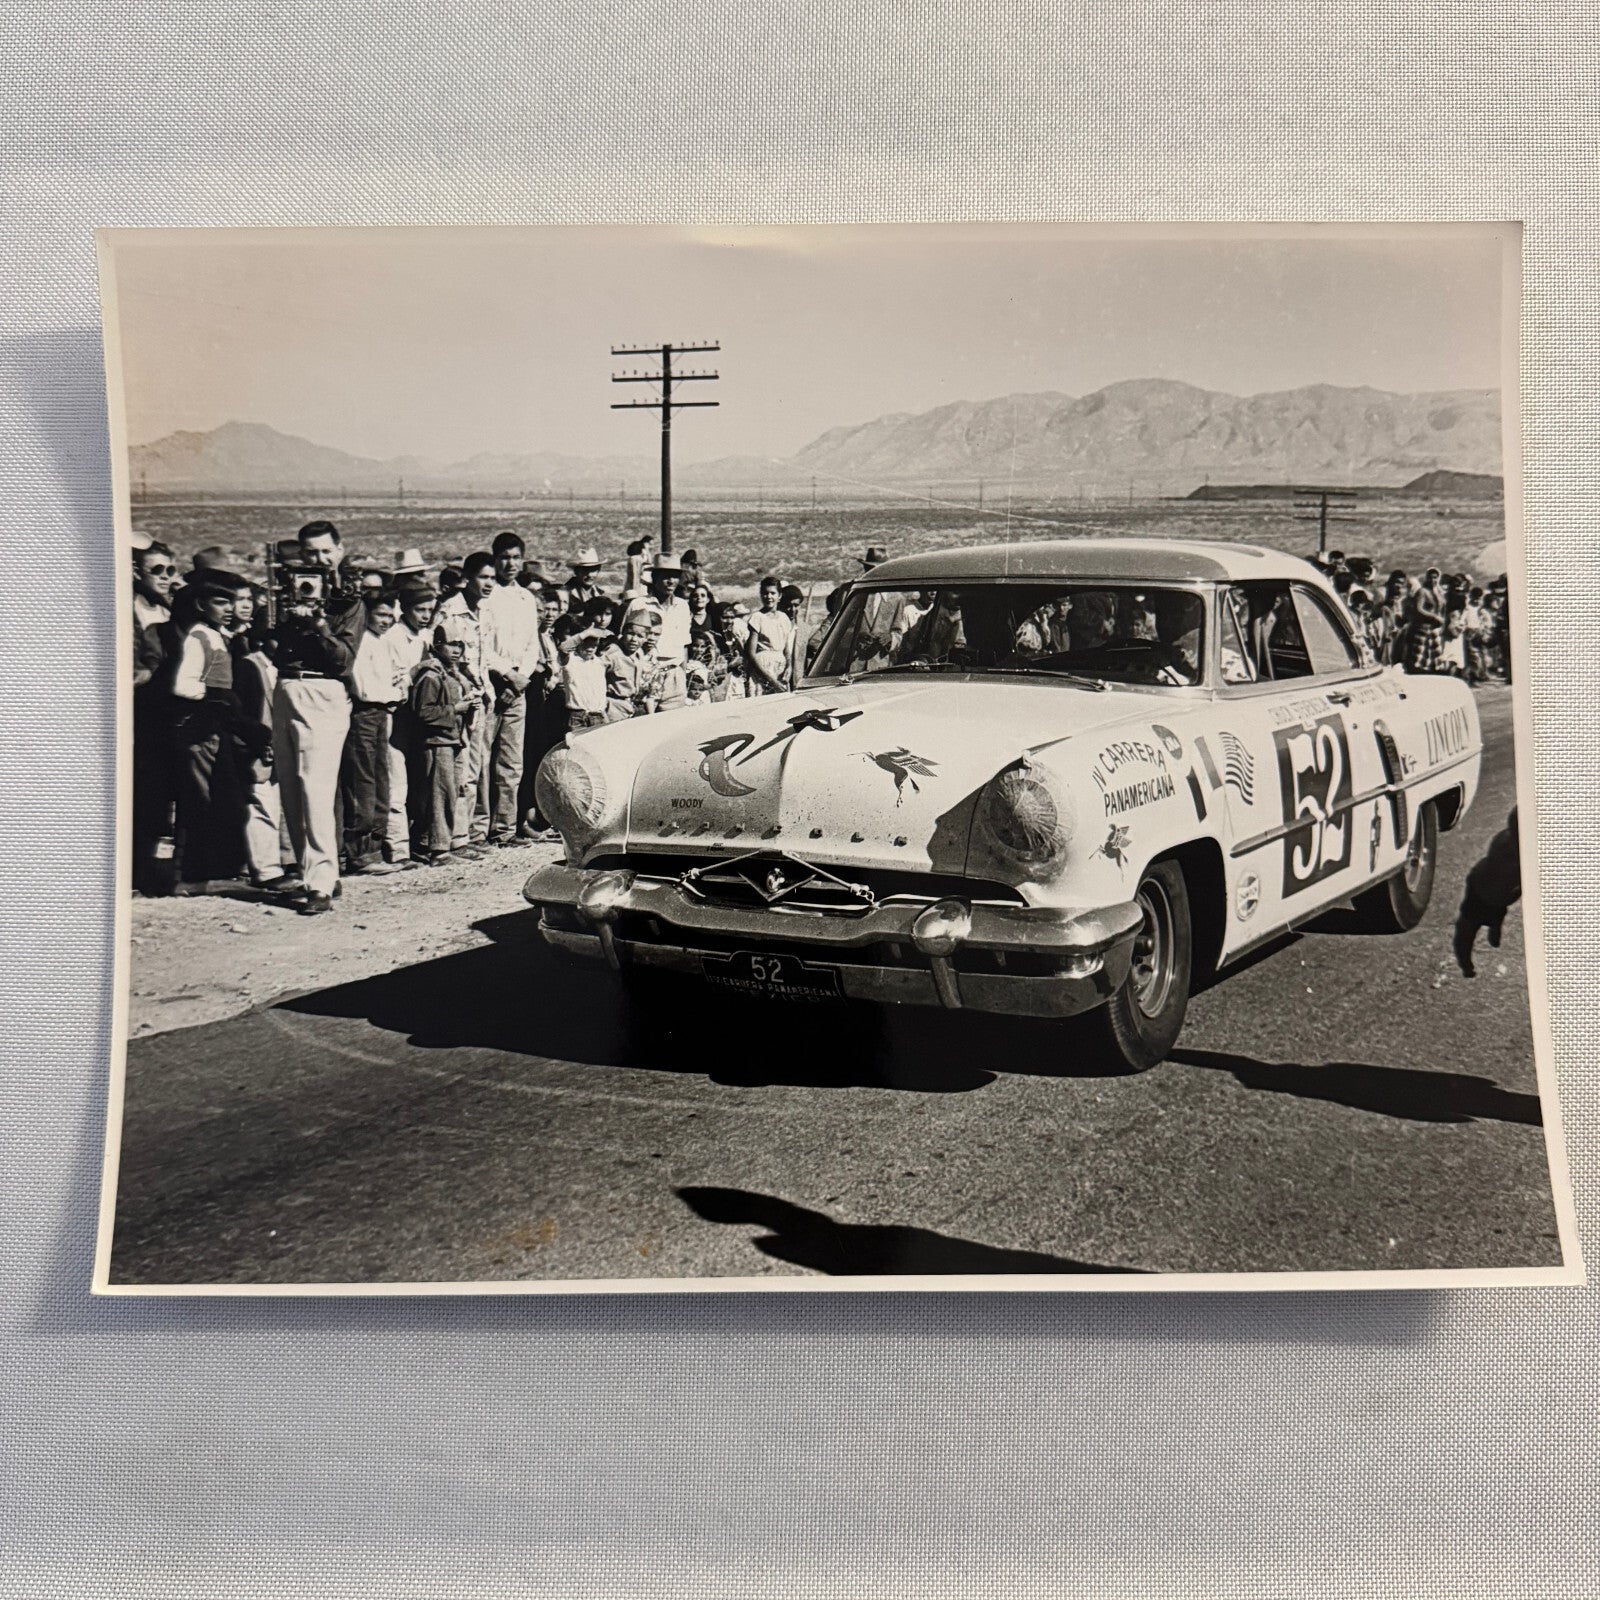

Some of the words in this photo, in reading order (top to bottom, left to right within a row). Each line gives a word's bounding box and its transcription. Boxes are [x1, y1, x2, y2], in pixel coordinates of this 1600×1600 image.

[1424, 706, 1470, 766] LINCOLN
[1098, 741, 1167, 774] CARRERA
[1092, 765, 1107, 793] IV
[1103, 773, 1176, 818] PANAMERICANA
[670, 798, 704, 809] WOODY
[1287, 724, 1344, 880] 52
[751, 955, 785, 983] 52
